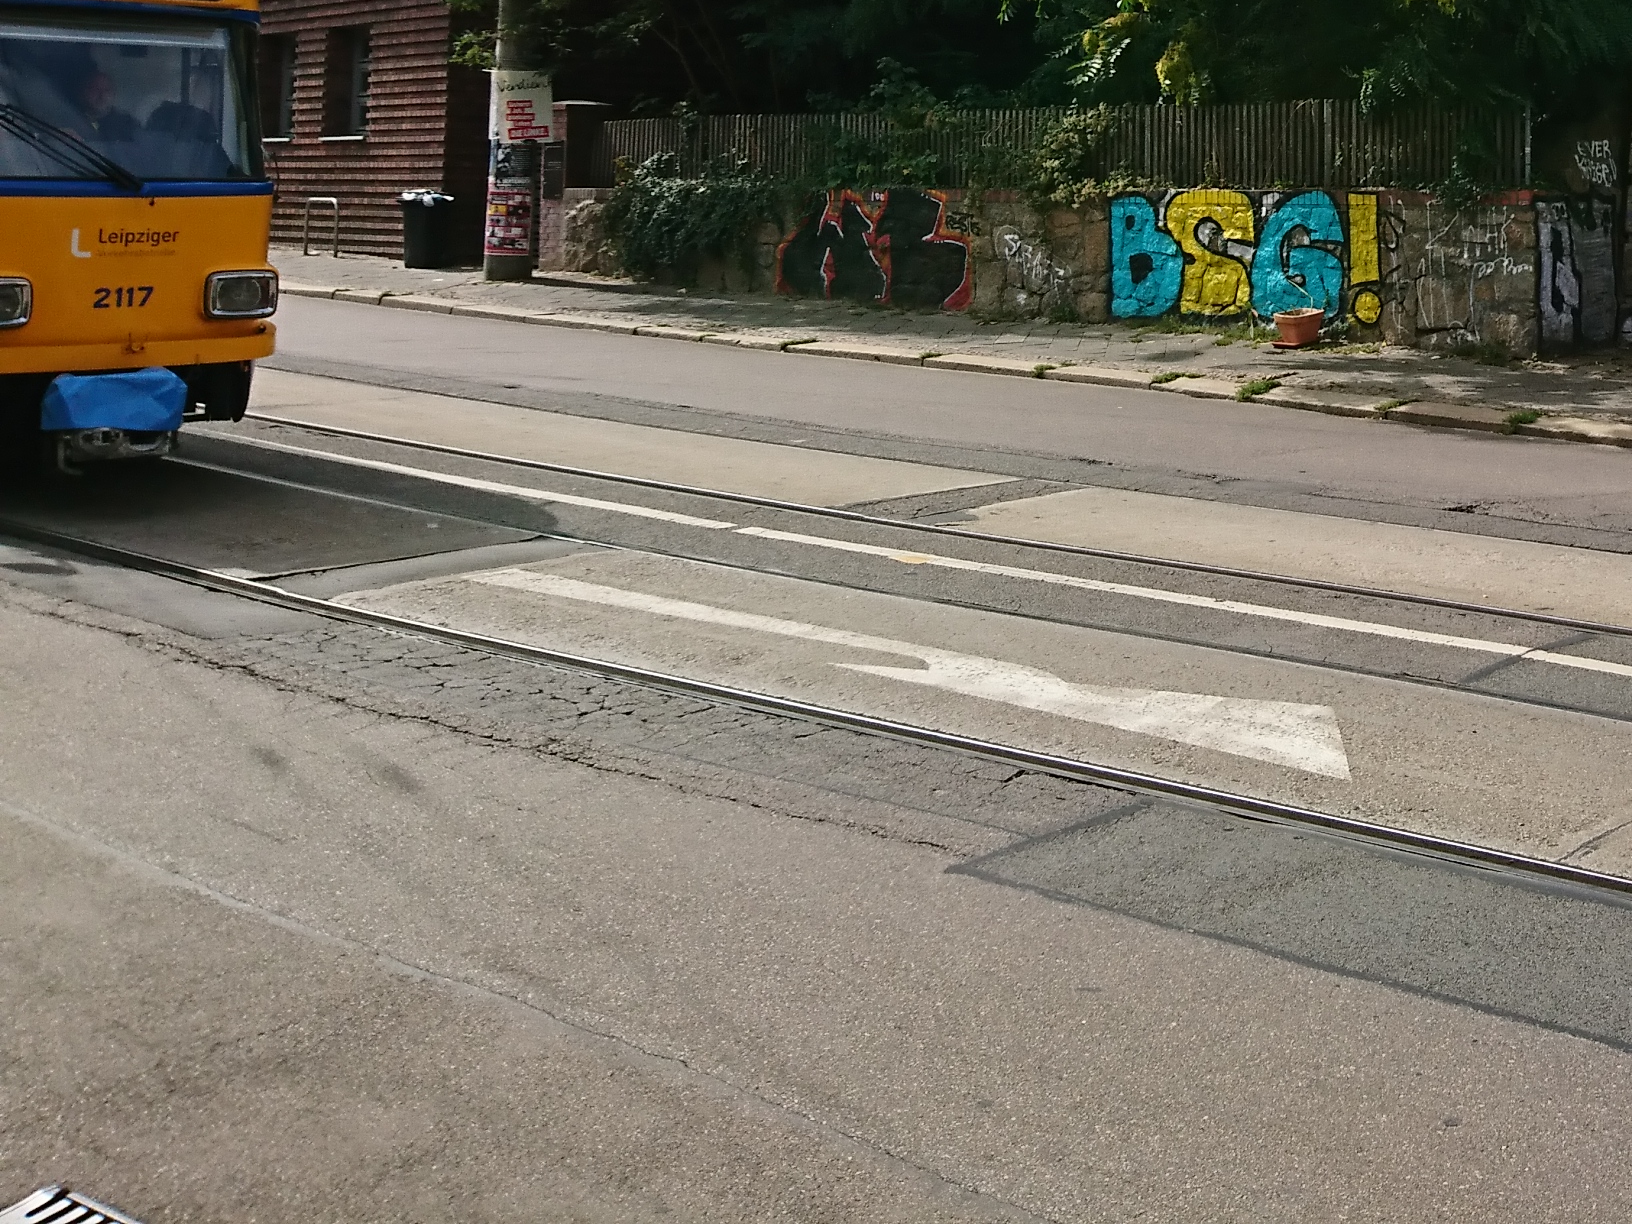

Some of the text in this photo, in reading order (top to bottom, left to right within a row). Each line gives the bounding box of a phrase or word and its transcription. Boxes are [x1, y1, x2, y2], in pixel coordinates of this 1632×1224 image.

[98, 228, 180, 247] Leipziger
[1109, 188, 1383, 325] BSG!
[93, 286, 154, 309] 2117
